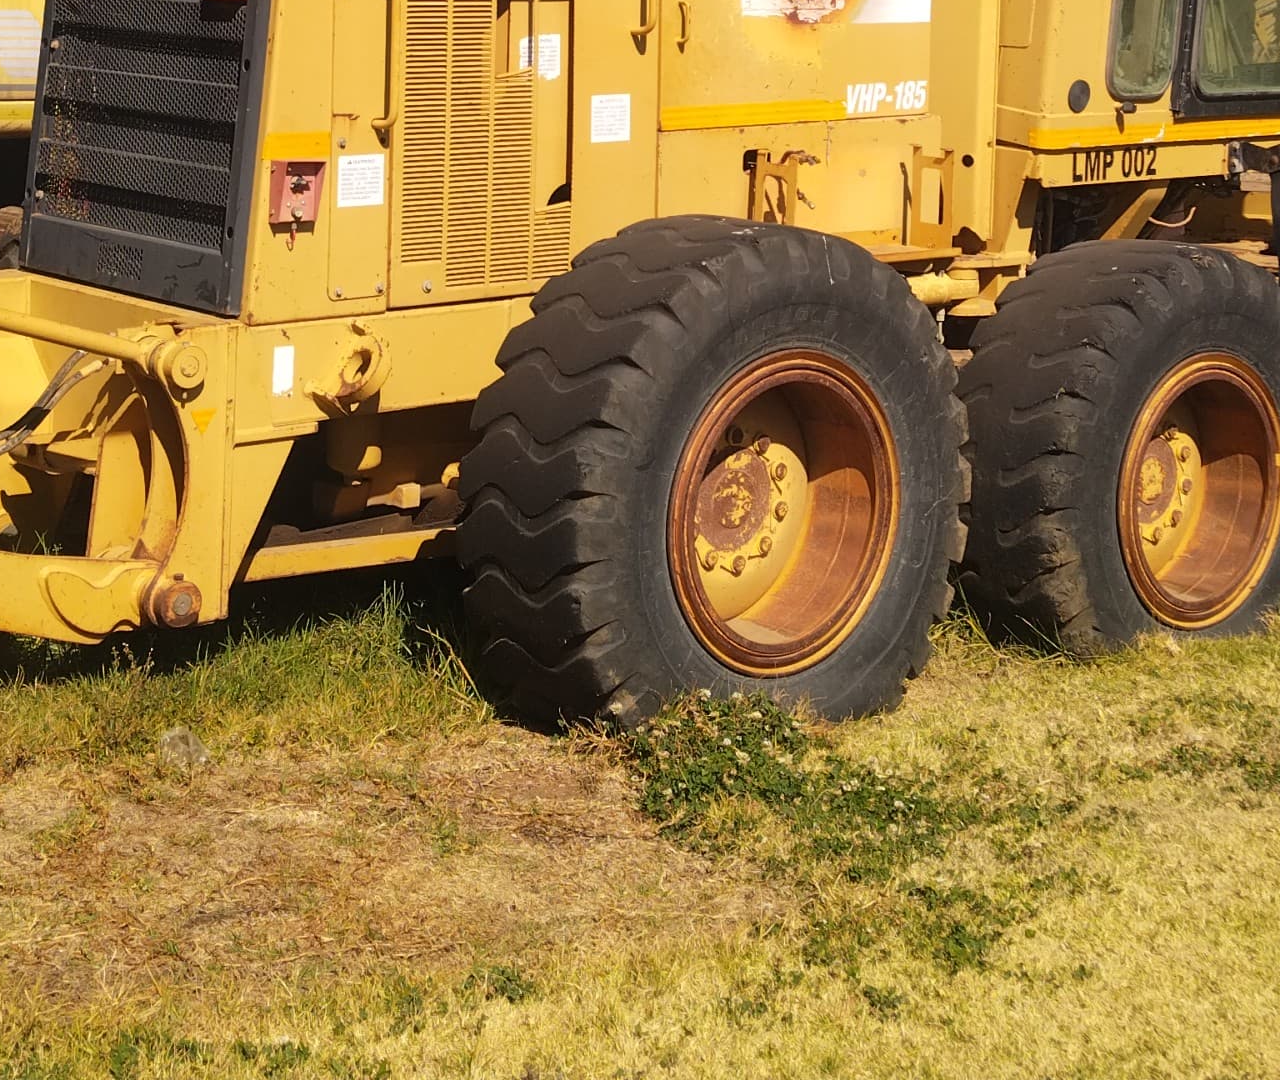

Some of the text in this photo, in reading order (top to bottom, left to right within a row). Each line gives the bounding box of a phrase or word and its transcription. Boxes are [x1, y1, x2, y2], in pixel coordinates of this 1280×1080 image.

[846, 80, 928, 114] VHP-185
[1072, 145, 1157, 183] LMP 002
